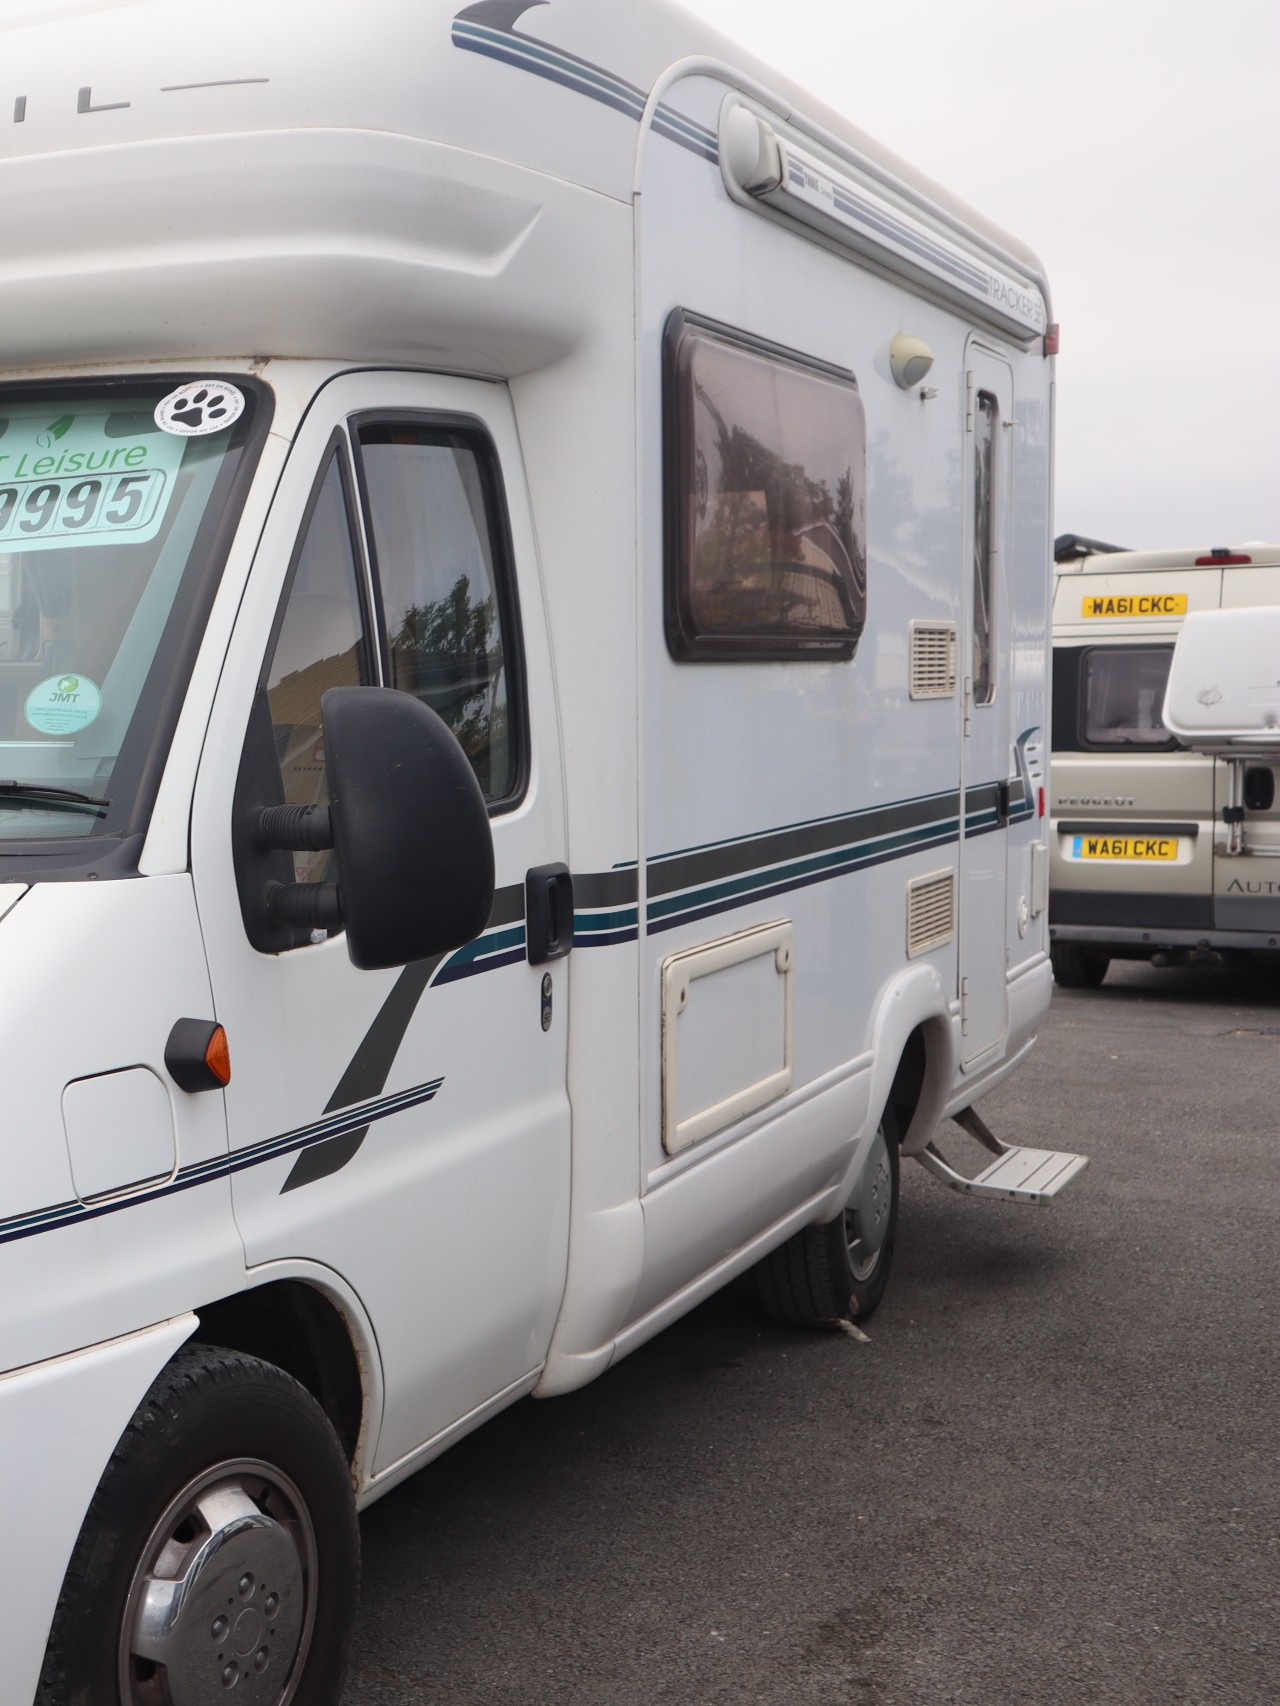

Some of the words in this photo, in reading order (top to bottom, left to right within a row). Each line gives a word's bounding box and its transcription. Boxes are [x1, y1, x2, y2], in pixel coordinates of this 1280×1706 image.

[988, 275, 1033, 320] TRACKER
[14, 445, 147, 479] Leisure
[1092, 598, 1133, 615] WA61
[1138, 597, 1175, 613] CKC
[49, 692, 81, 703] JMT
[1088, 839, 1128, 855] WA61
[1133, 840, 1169, 857] CKC
[1227, 878, 1280, 894] AUT
